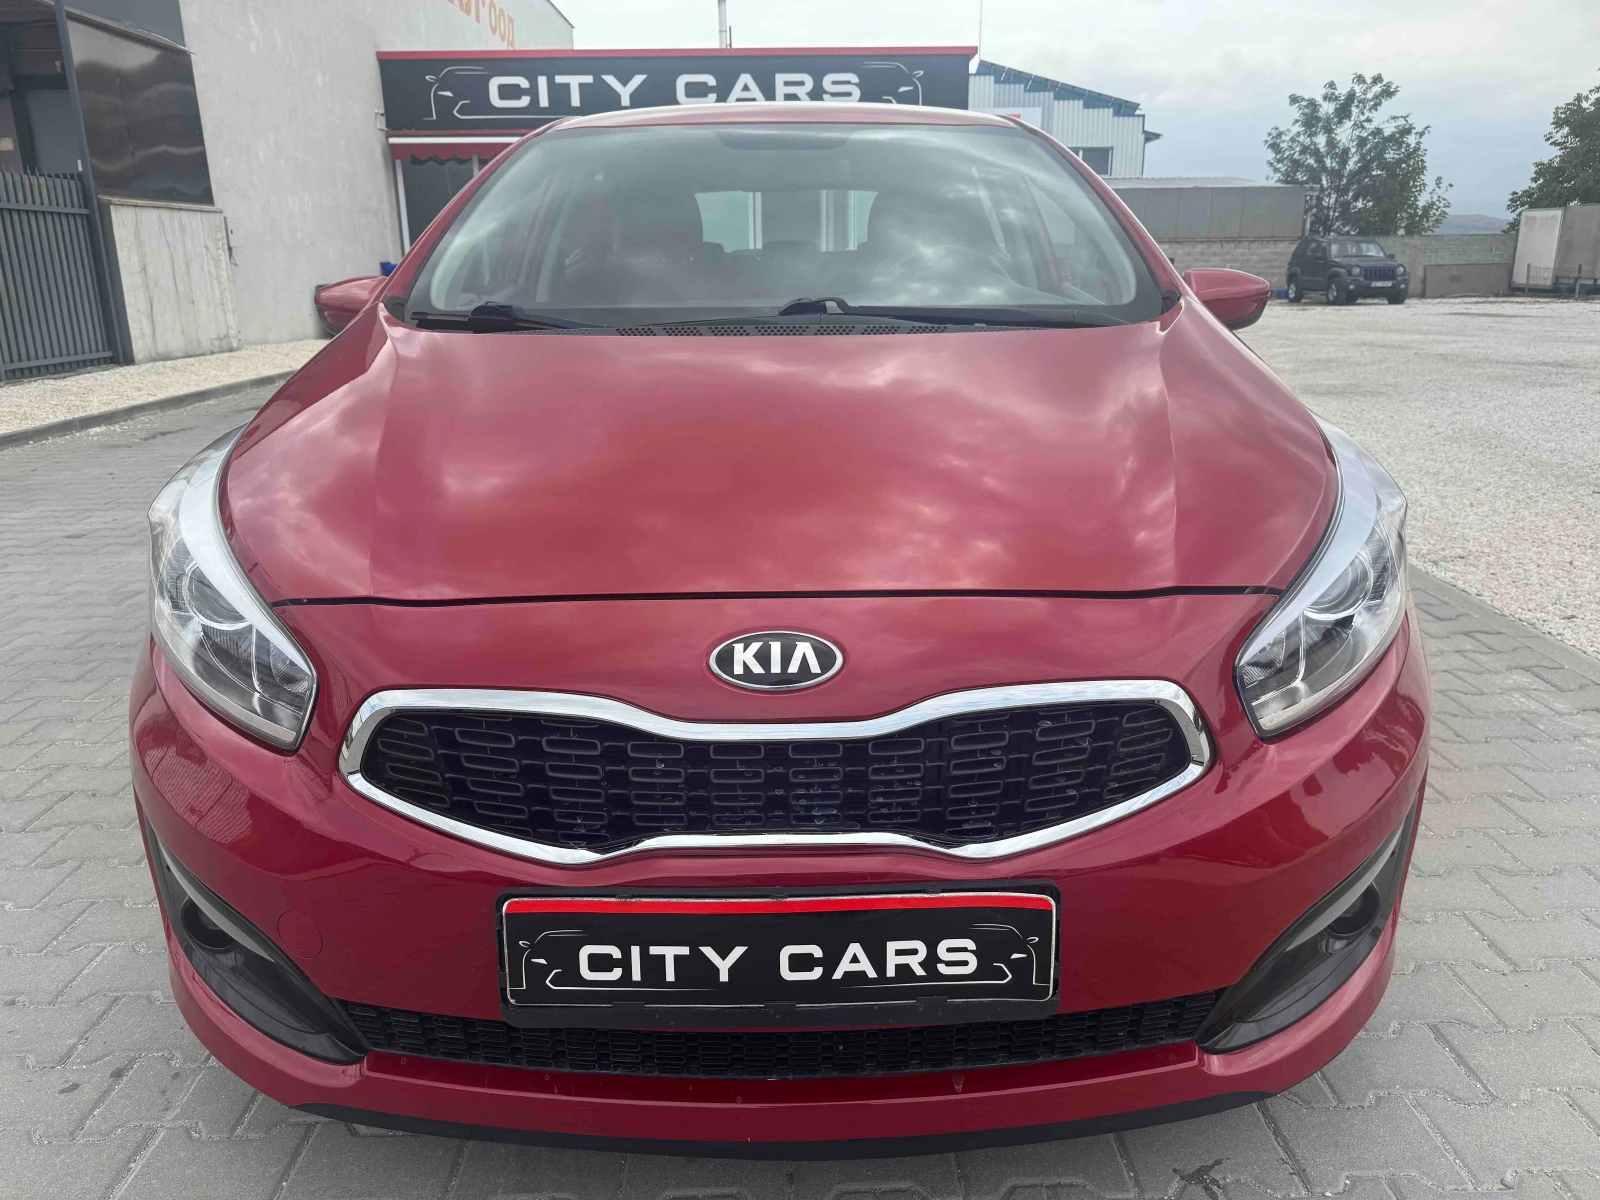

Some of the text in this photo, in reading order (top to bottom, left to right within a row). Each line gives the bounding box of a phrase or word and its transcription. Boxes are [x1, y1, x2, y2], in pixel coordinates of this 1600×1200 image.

[488, 73, 861, 108] CITY CARS
[732, 641, 822, 675] KIA
[578, 938, 978, 982] CITY CARS
